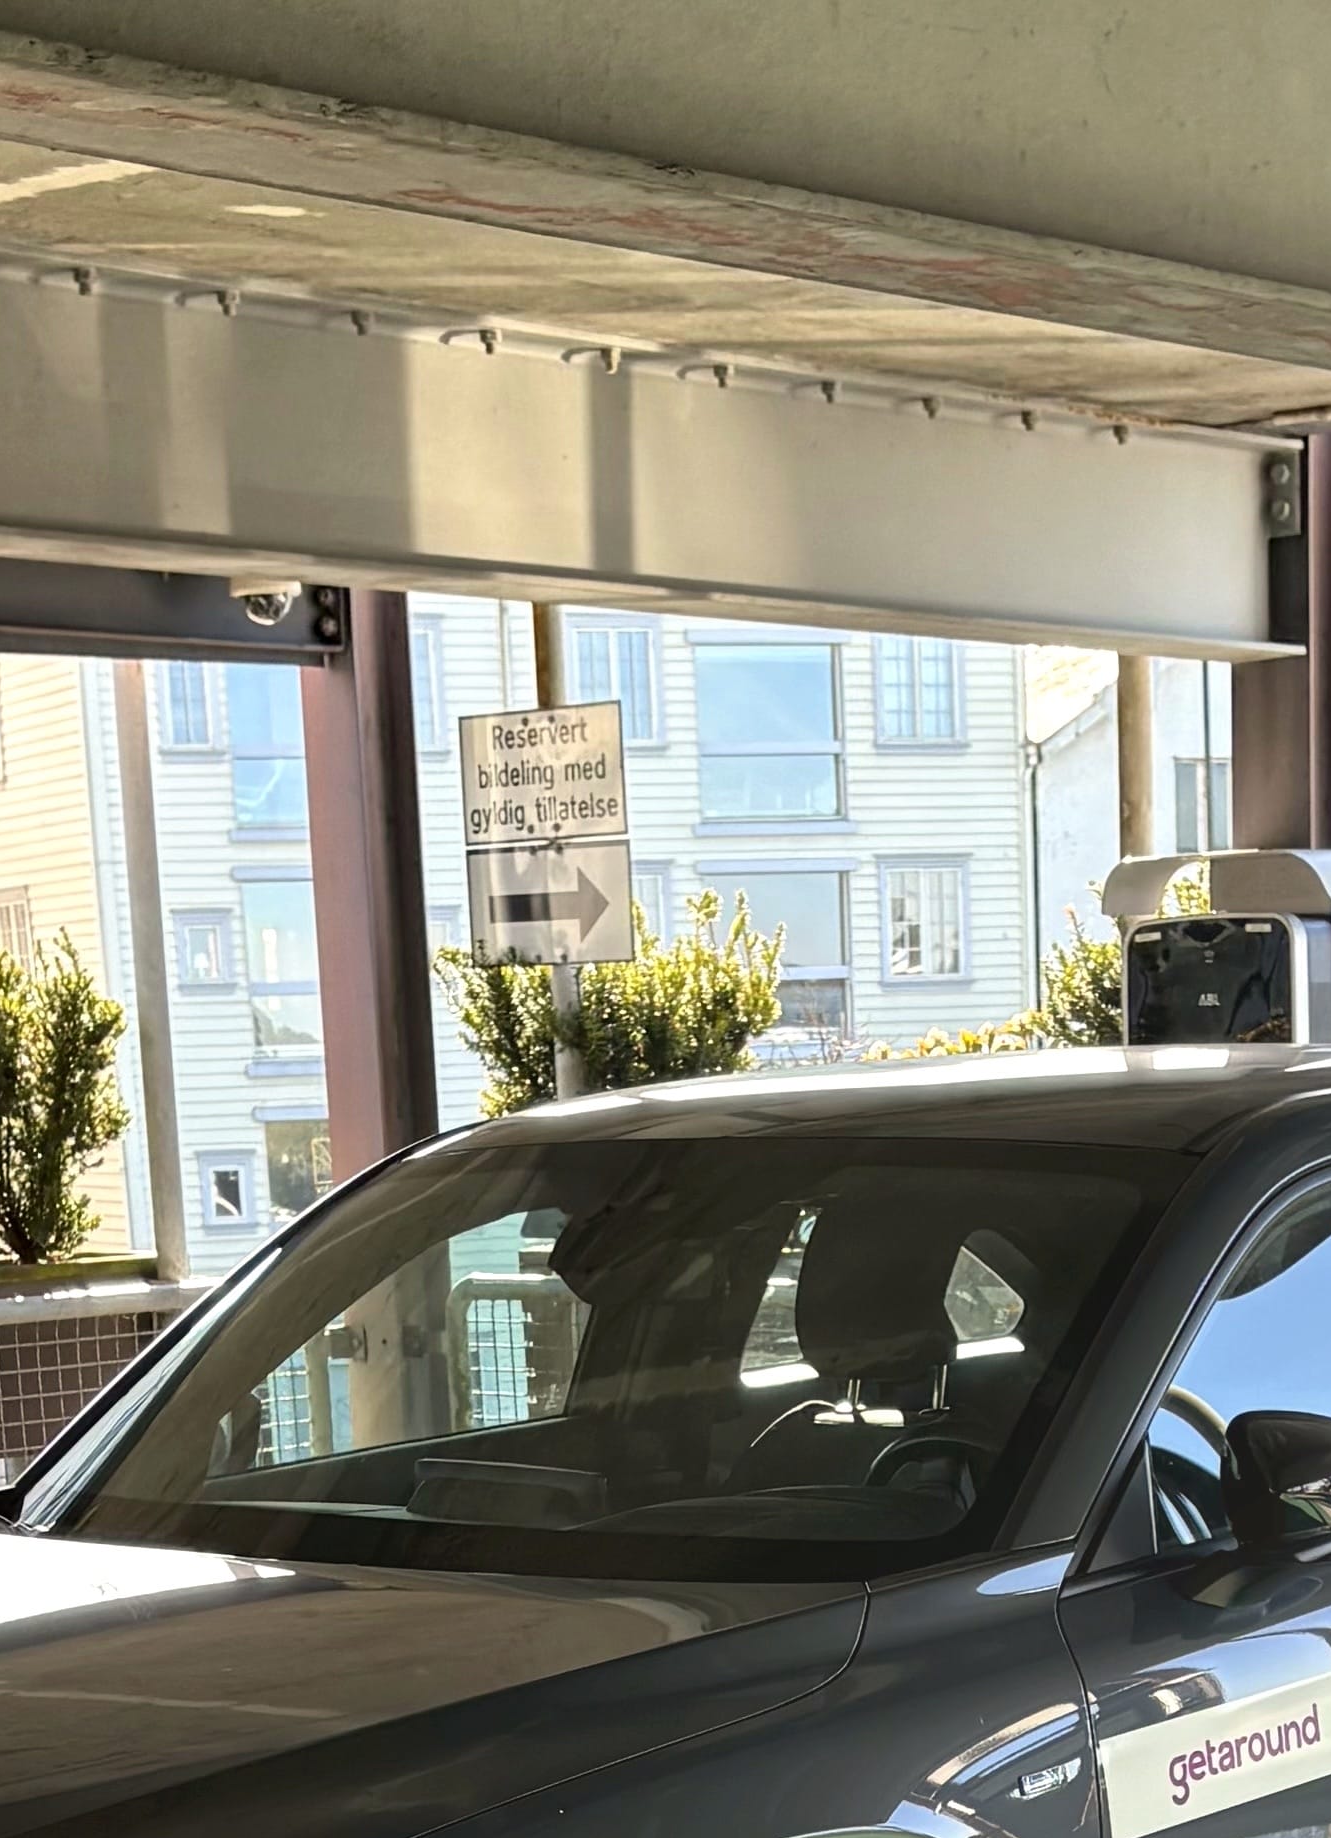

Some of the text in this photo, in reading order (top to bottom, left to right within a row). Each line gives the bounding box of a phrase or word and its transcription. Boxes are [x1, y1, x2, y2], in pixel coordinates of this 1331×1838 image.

[492, 717, 588, 750] Reservert
[478, 753, 606, 790] bildeling med
[470, 792, 619, 834] gyldig tillatelse
[1169, 1703, 1321, 1805] getaround
